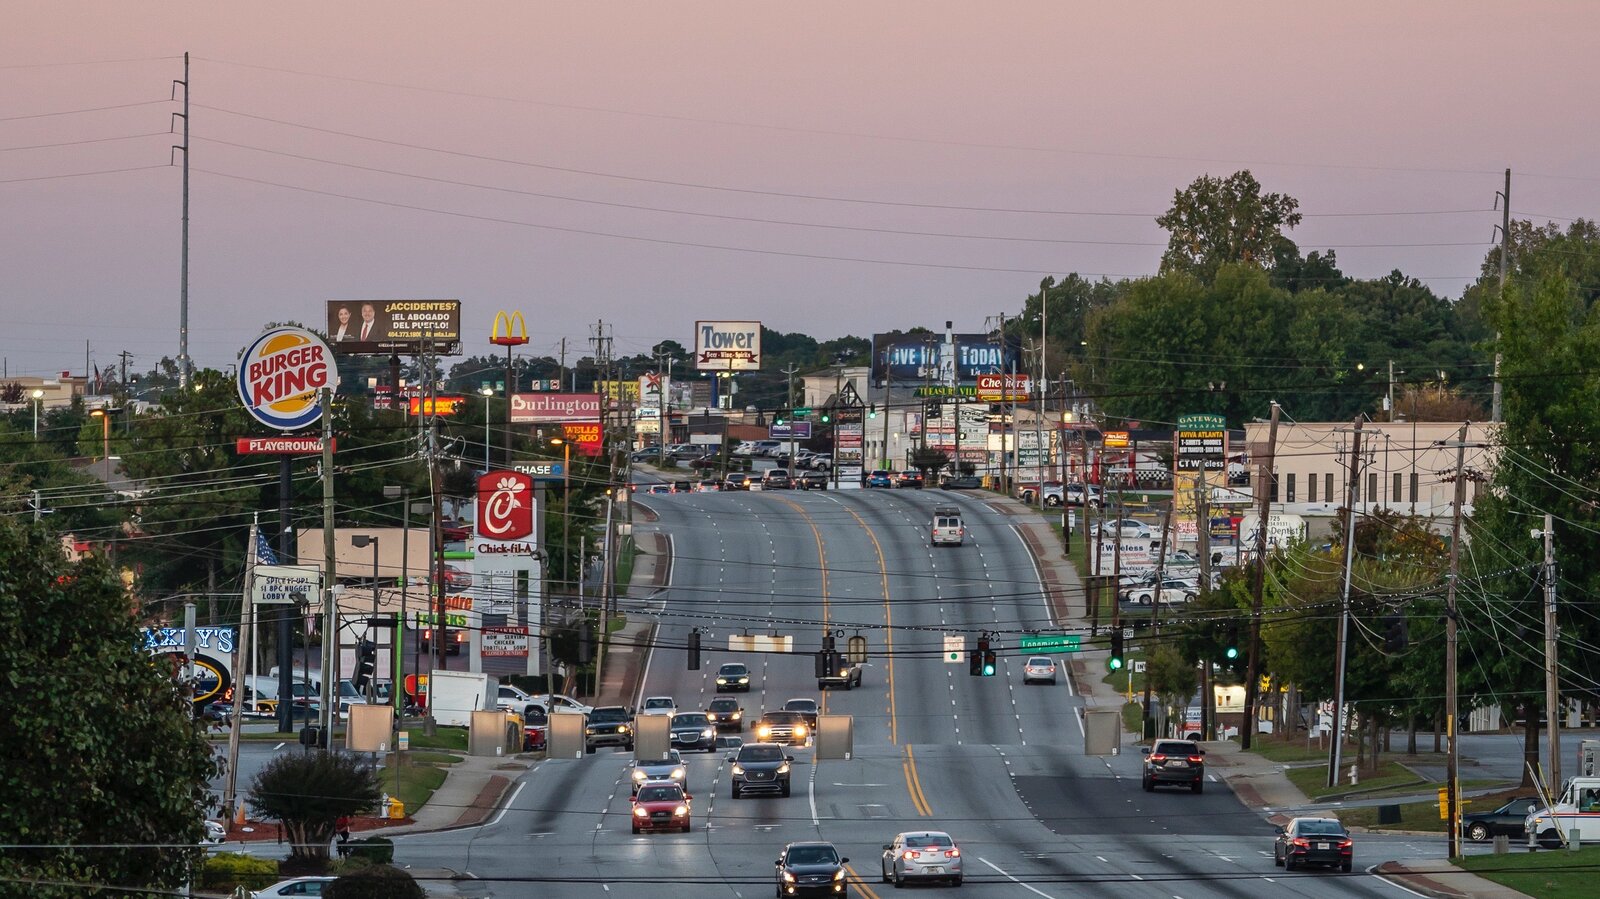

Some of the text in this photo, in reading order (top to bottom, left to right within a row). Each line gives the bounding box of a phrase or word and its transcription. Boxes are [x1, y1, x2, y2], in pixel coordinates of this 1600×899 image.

[385, 302, 456, 312] ¿ACCIDENTES?
[702, 326, 754, 348] Tower
[250, 346, 324, 383] BURGER
[253, 362, 328, 408] KING
[511, 394, 600, 415] Burlington
[1180, 416, 1224, 424] GATEWAY
[250, 442, 324, 451] PLAYGROUND
[514, 466, 550, 474] CHASE
[478, 543, 532, 553] Chick-fil-A
